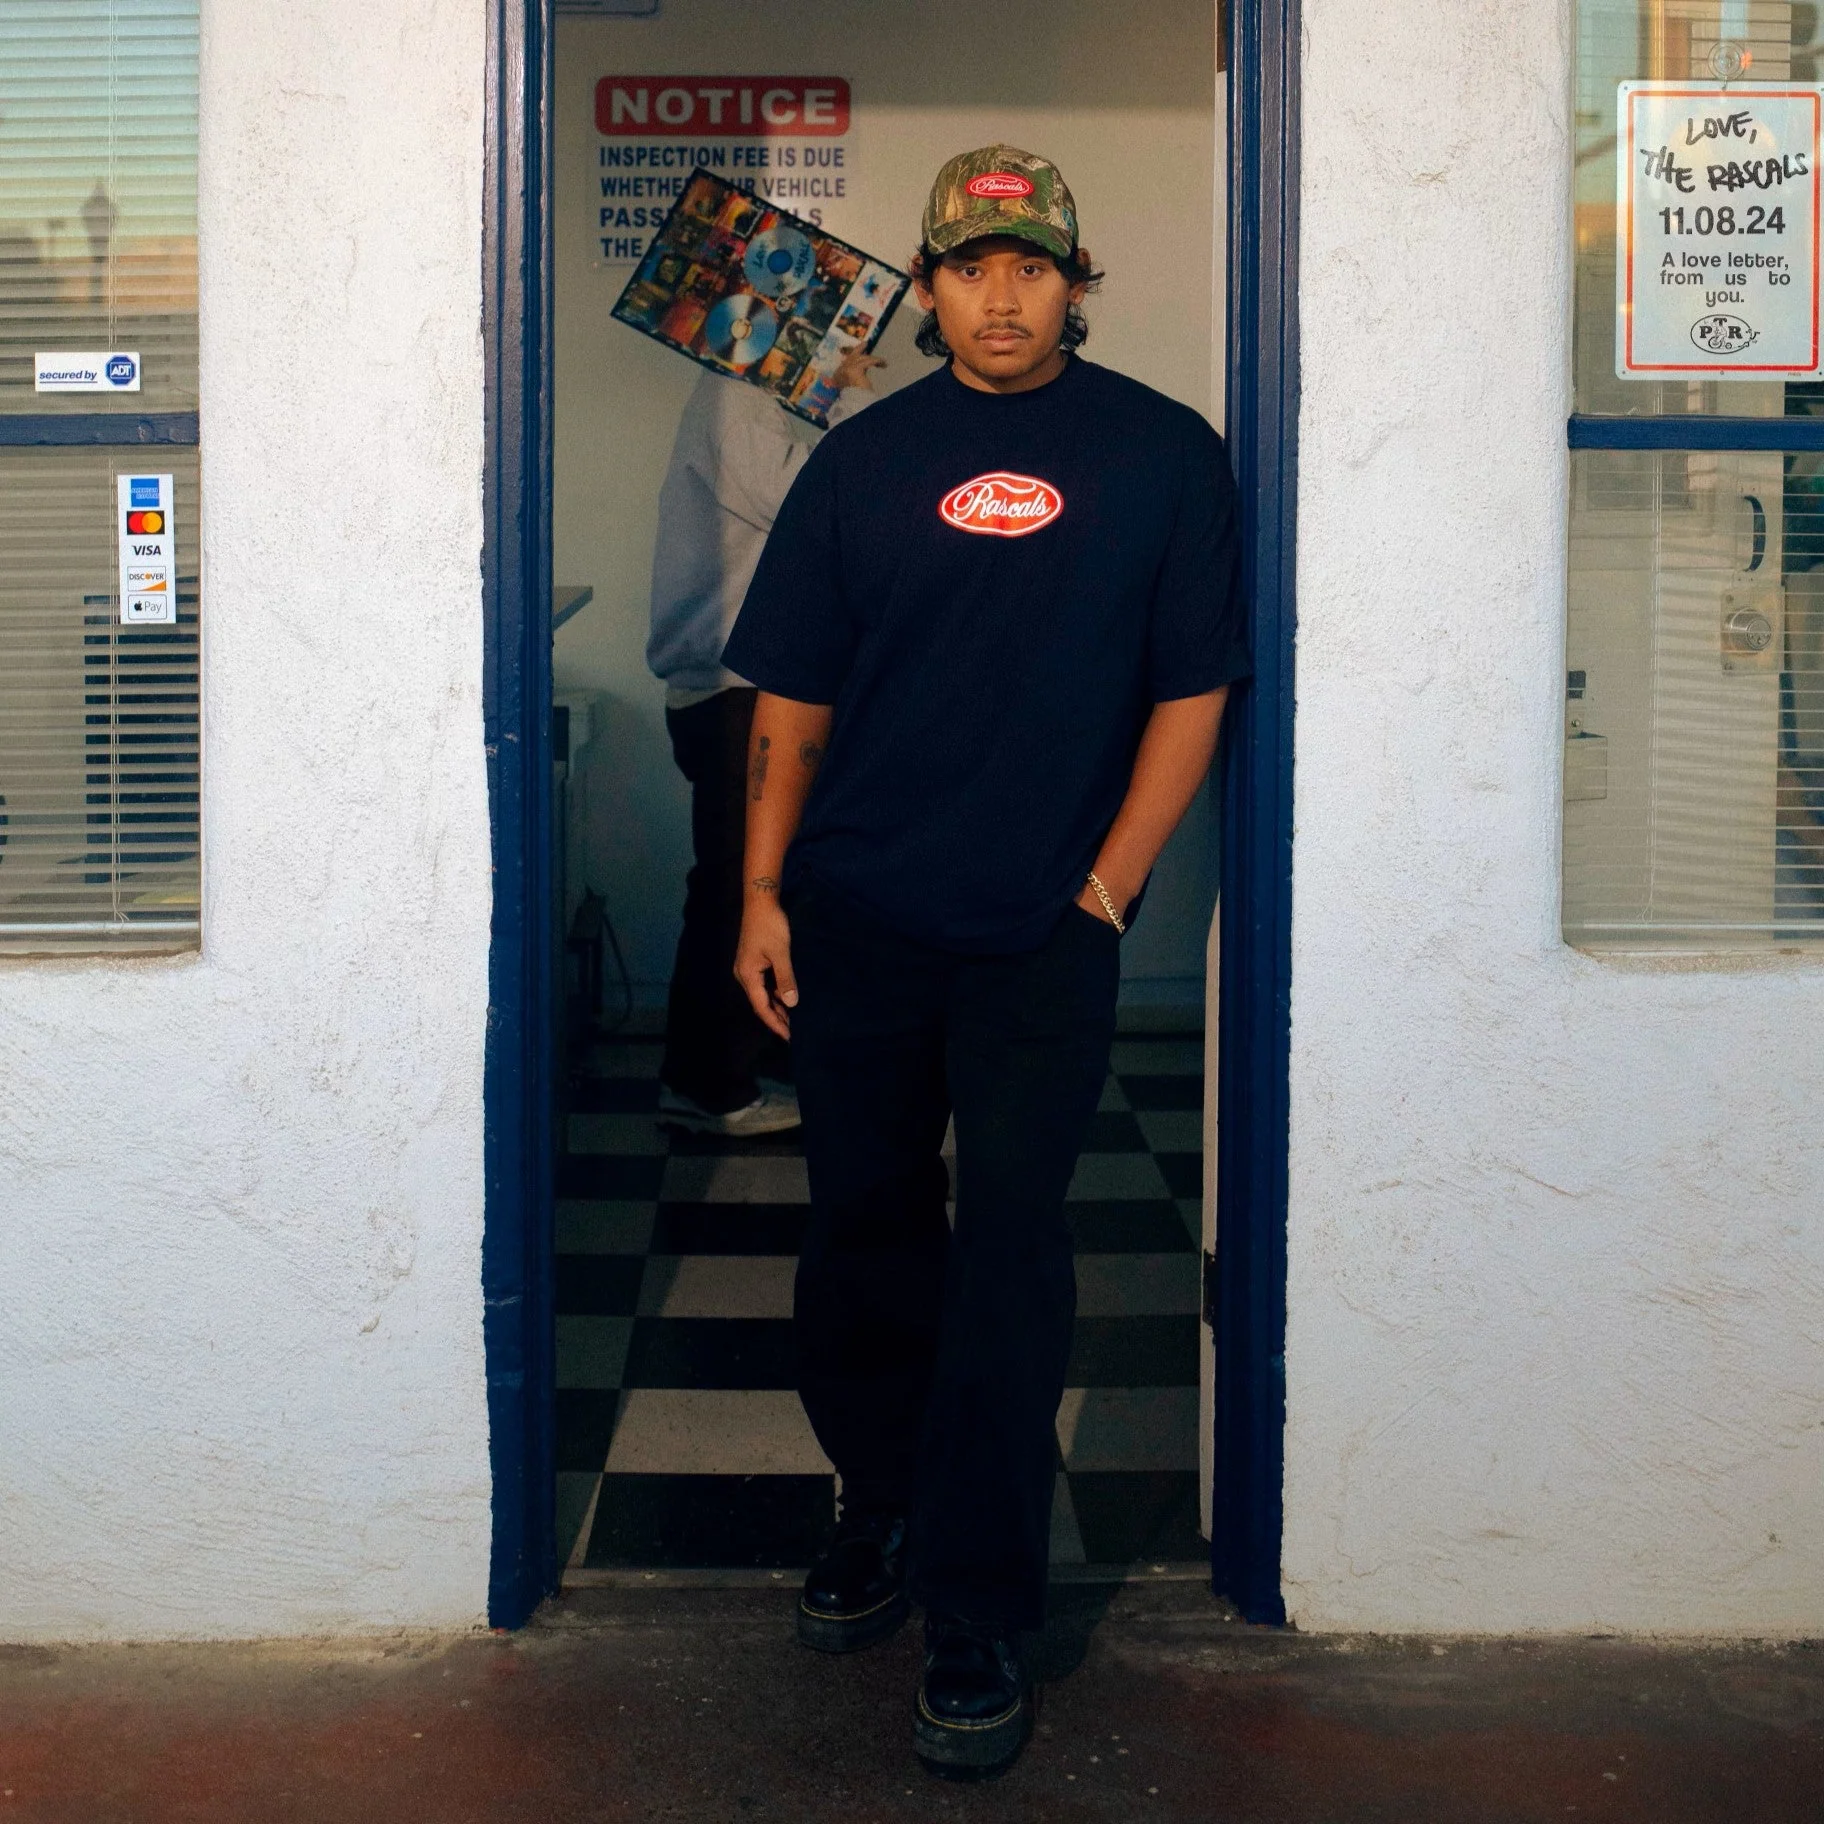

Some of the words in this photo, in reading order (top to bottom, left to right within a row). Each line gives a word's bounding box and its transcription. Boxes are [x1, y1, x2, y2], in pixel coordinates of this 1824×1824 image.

[610, 88, 838, 125] NOTICE
[1685, 110, 1758, 146] LOVE,
[600, 146, 727, 168] INSPECTION
[732, 147, 770, 167] FEE
[777, 147, 797, 167] IS
[803, 147, 844, 168] DUE
[1639, 145, 1696, 194] THE
[1706, 152, 1809, 193] RASCALS
[600, 177, 690, 197] WHETHE
[762, 178, 846, 198] VEHICLE
[1658, 205, 1787, 236] 11.08.24
[600, 237, 643, 258] THE
[1661, 251, 1676, 268] A
[1682, 251, 1722, 268] love
[1727, 251, 1790, 271] letter,
[1659, 269, 1704, 285] from
[1724, 272, 1748, 286] us
[1768, 270, 1792, 286] to
[1705, 290, 1746, 308] you.
[39, 370, 83, 380] secured
[84, 370, 98, 381] by
[111, 364, 131, 377] ADT
[953, 481, 1052, 520] Rascals
[132, 545, 162, 556] VISA
[129, 572, 165, 581] DISCOVER
[144, 601, 162, 614] Pay
